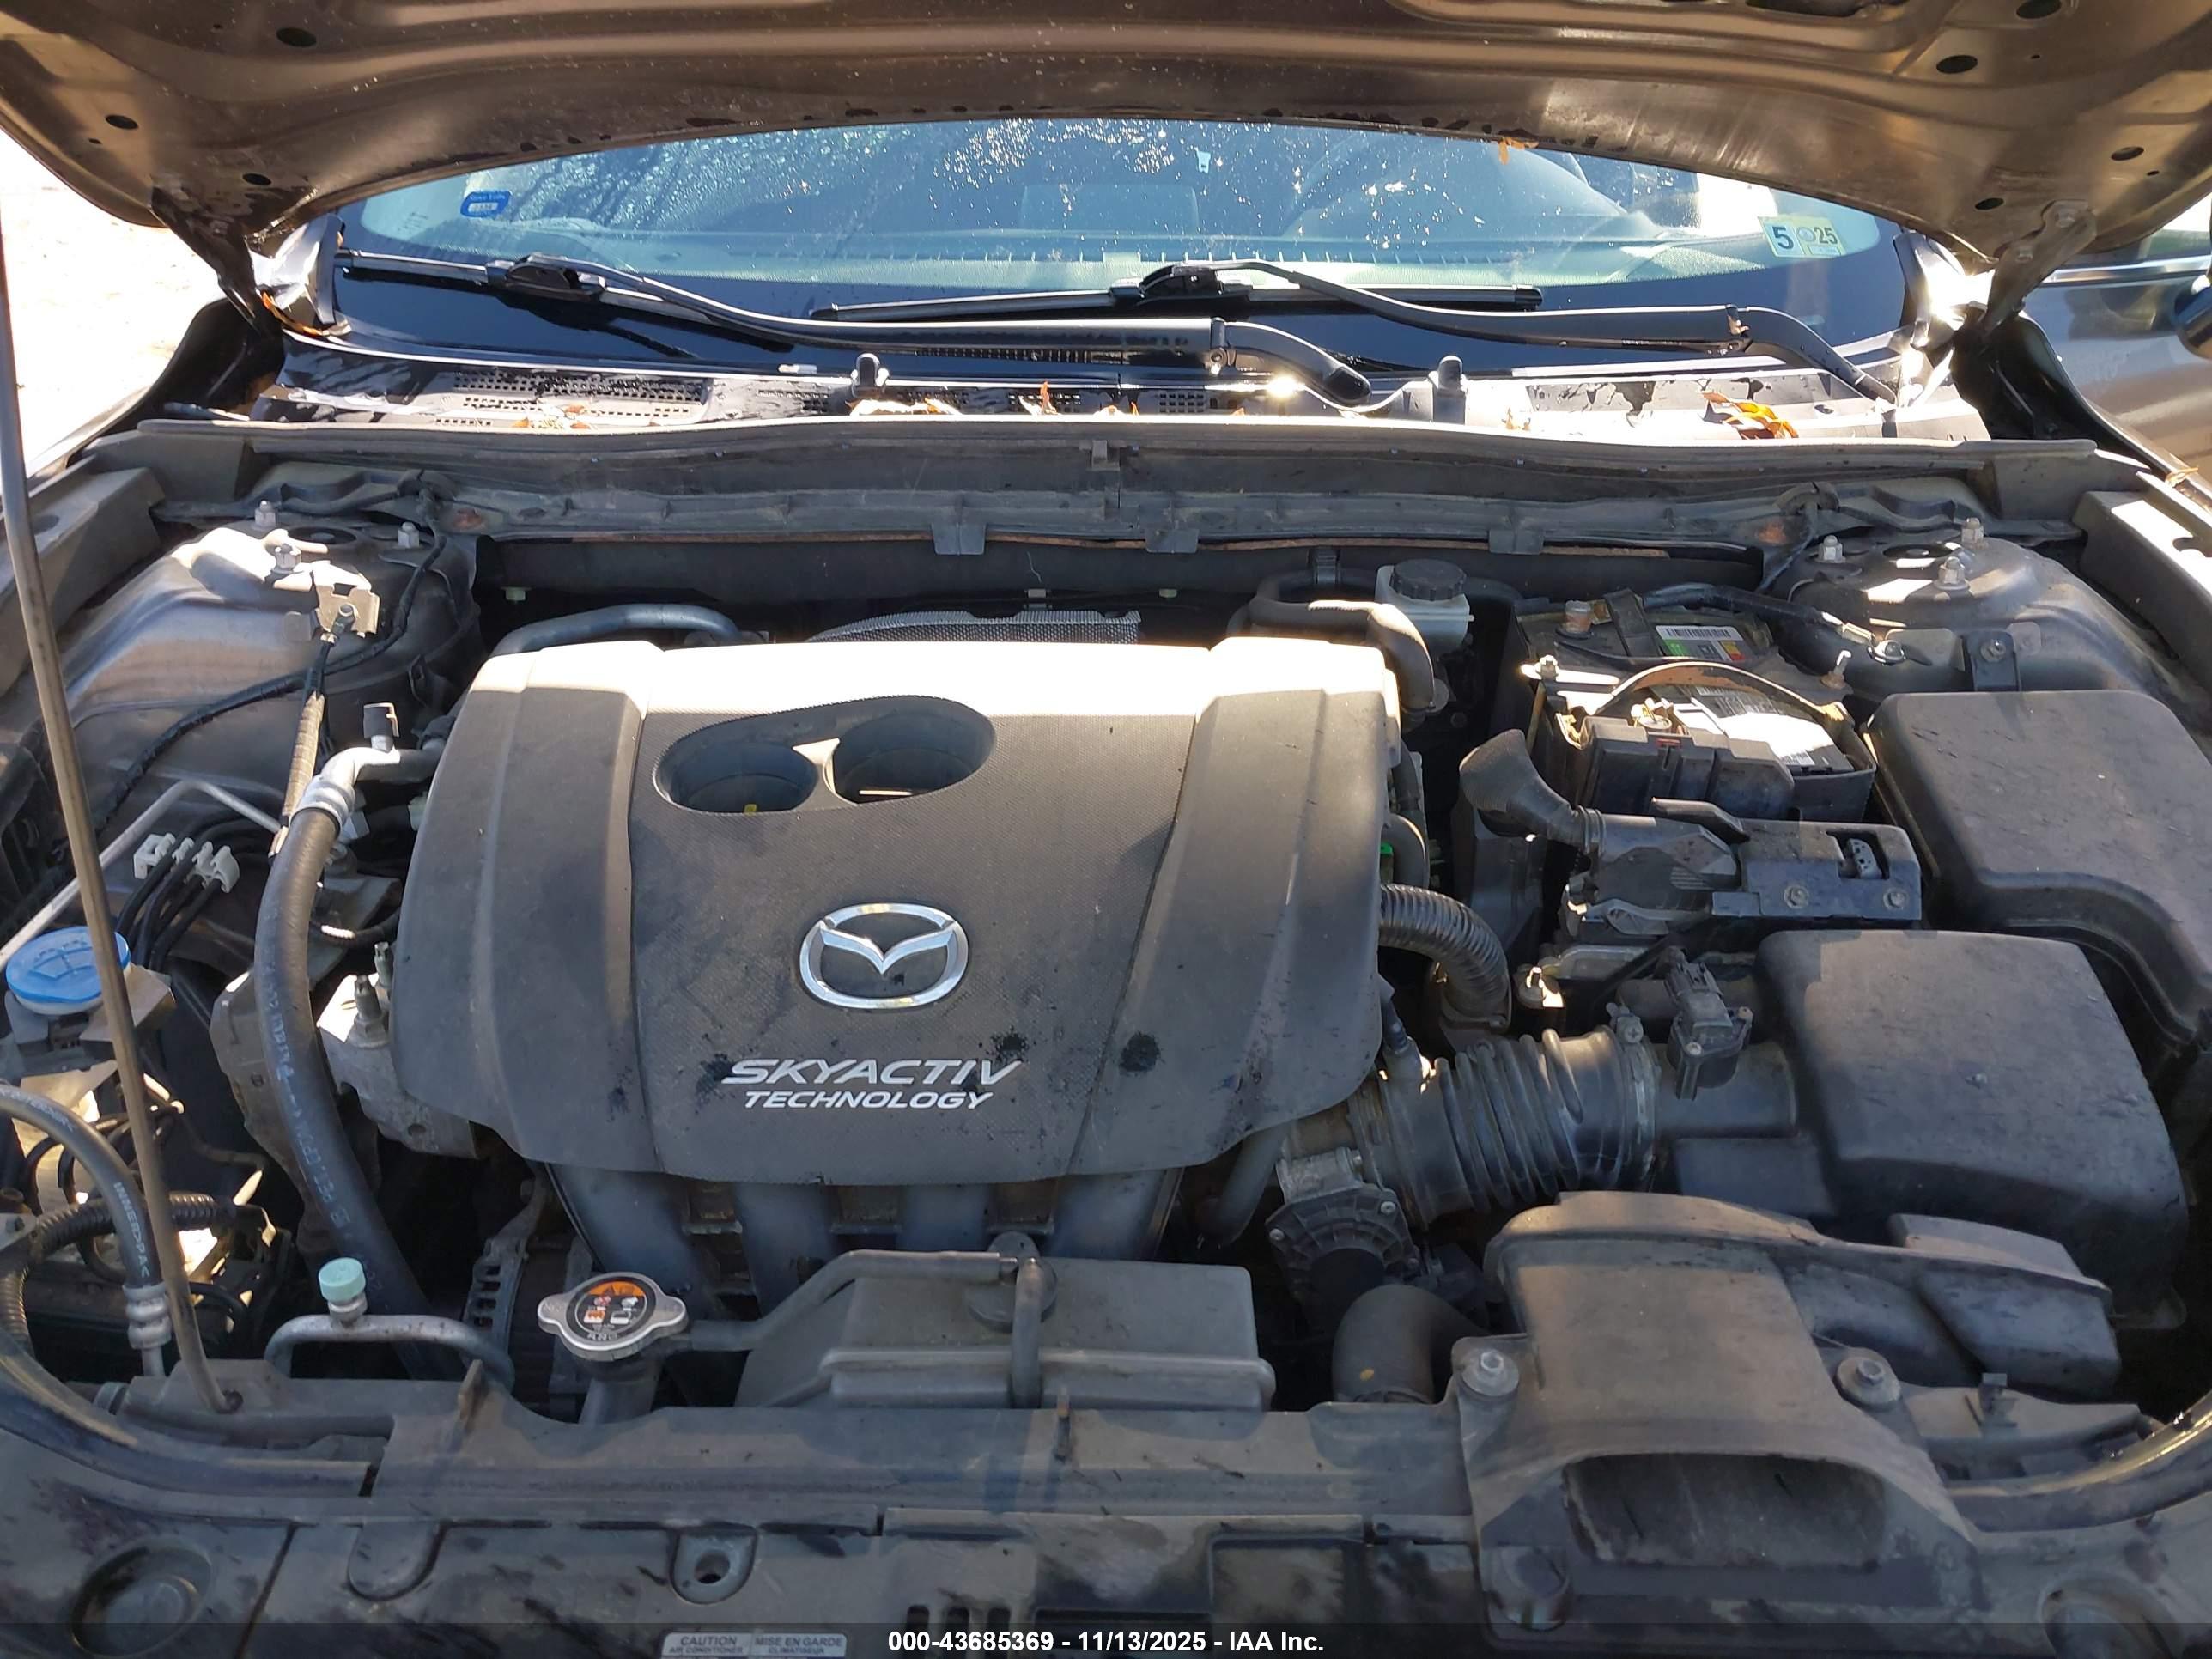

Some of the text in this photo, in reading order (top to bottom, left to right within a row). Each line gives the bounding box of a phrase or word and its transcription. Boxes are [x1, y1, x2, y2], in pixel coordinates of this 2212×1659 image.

[1772, 226, 1838, 250] 5 25
[721, 1059, 1023, 1085] SKYACTIV
[745, 1091, 994, 1109] TECHNOLOGY
[681, 1636, 738, 1646] CAUTION
[755, 1637, 842, 1647] MISE EN GARDE
